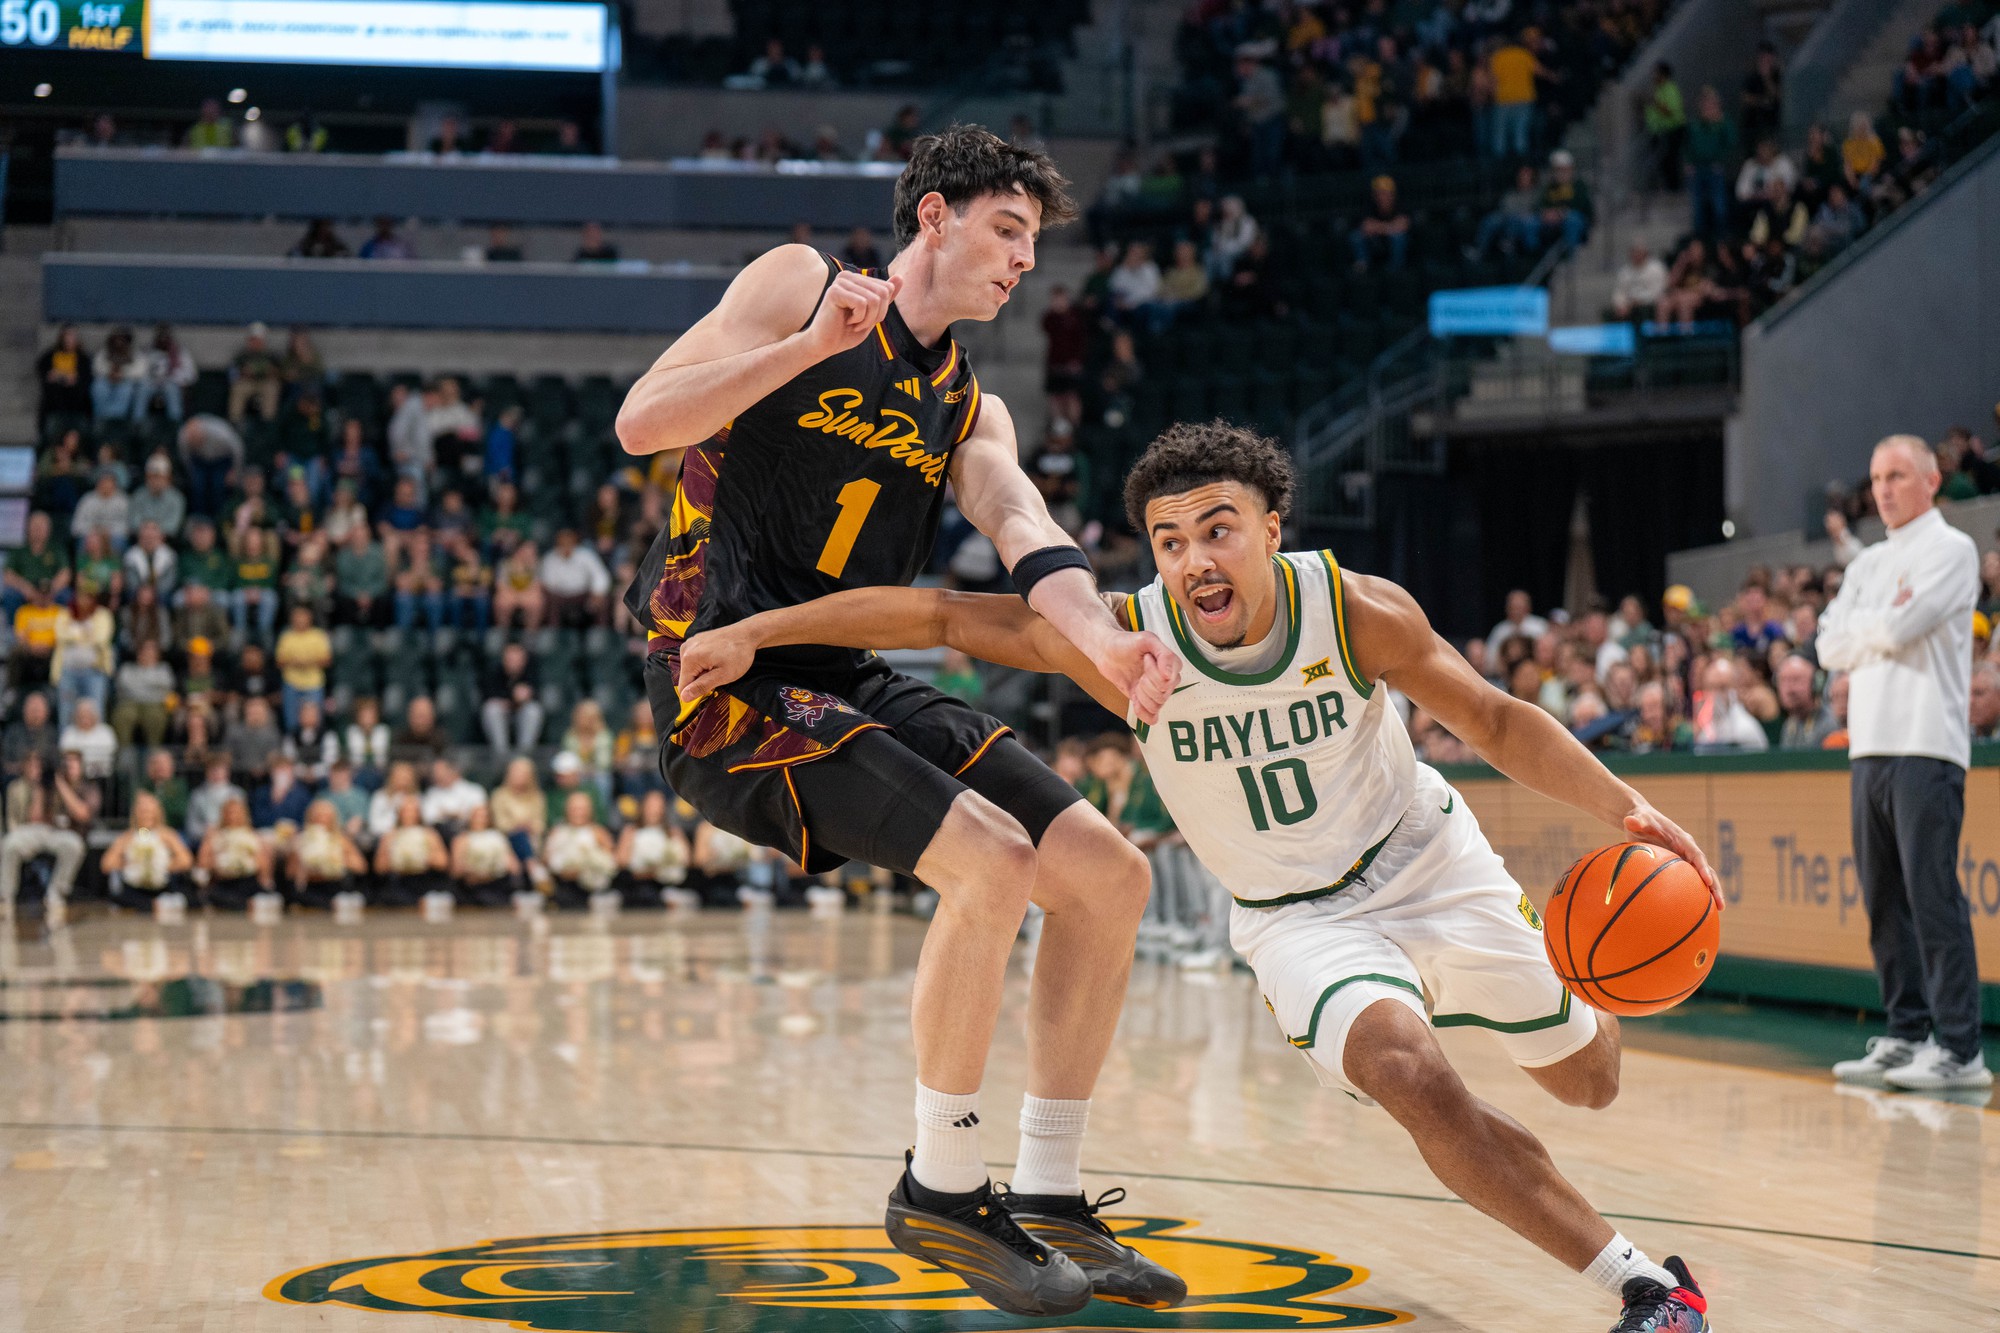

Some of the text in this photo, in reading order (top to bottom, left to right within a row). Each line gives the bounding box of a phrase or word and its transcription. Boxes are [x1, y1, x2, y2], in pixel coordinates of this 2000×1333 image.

[0, 0, 60, 45] 50
[69, 25, 133, 51] HALF
[798, 388, 875, 444] Sun
[816, 478, 882, 579] 1
[1301, 657, 1334, 686] XII
[1168, 691, 1348, 762] BAYLOR
[1236, 758, 1318, 831] 10
[1771, 830, 1830, 905] The
